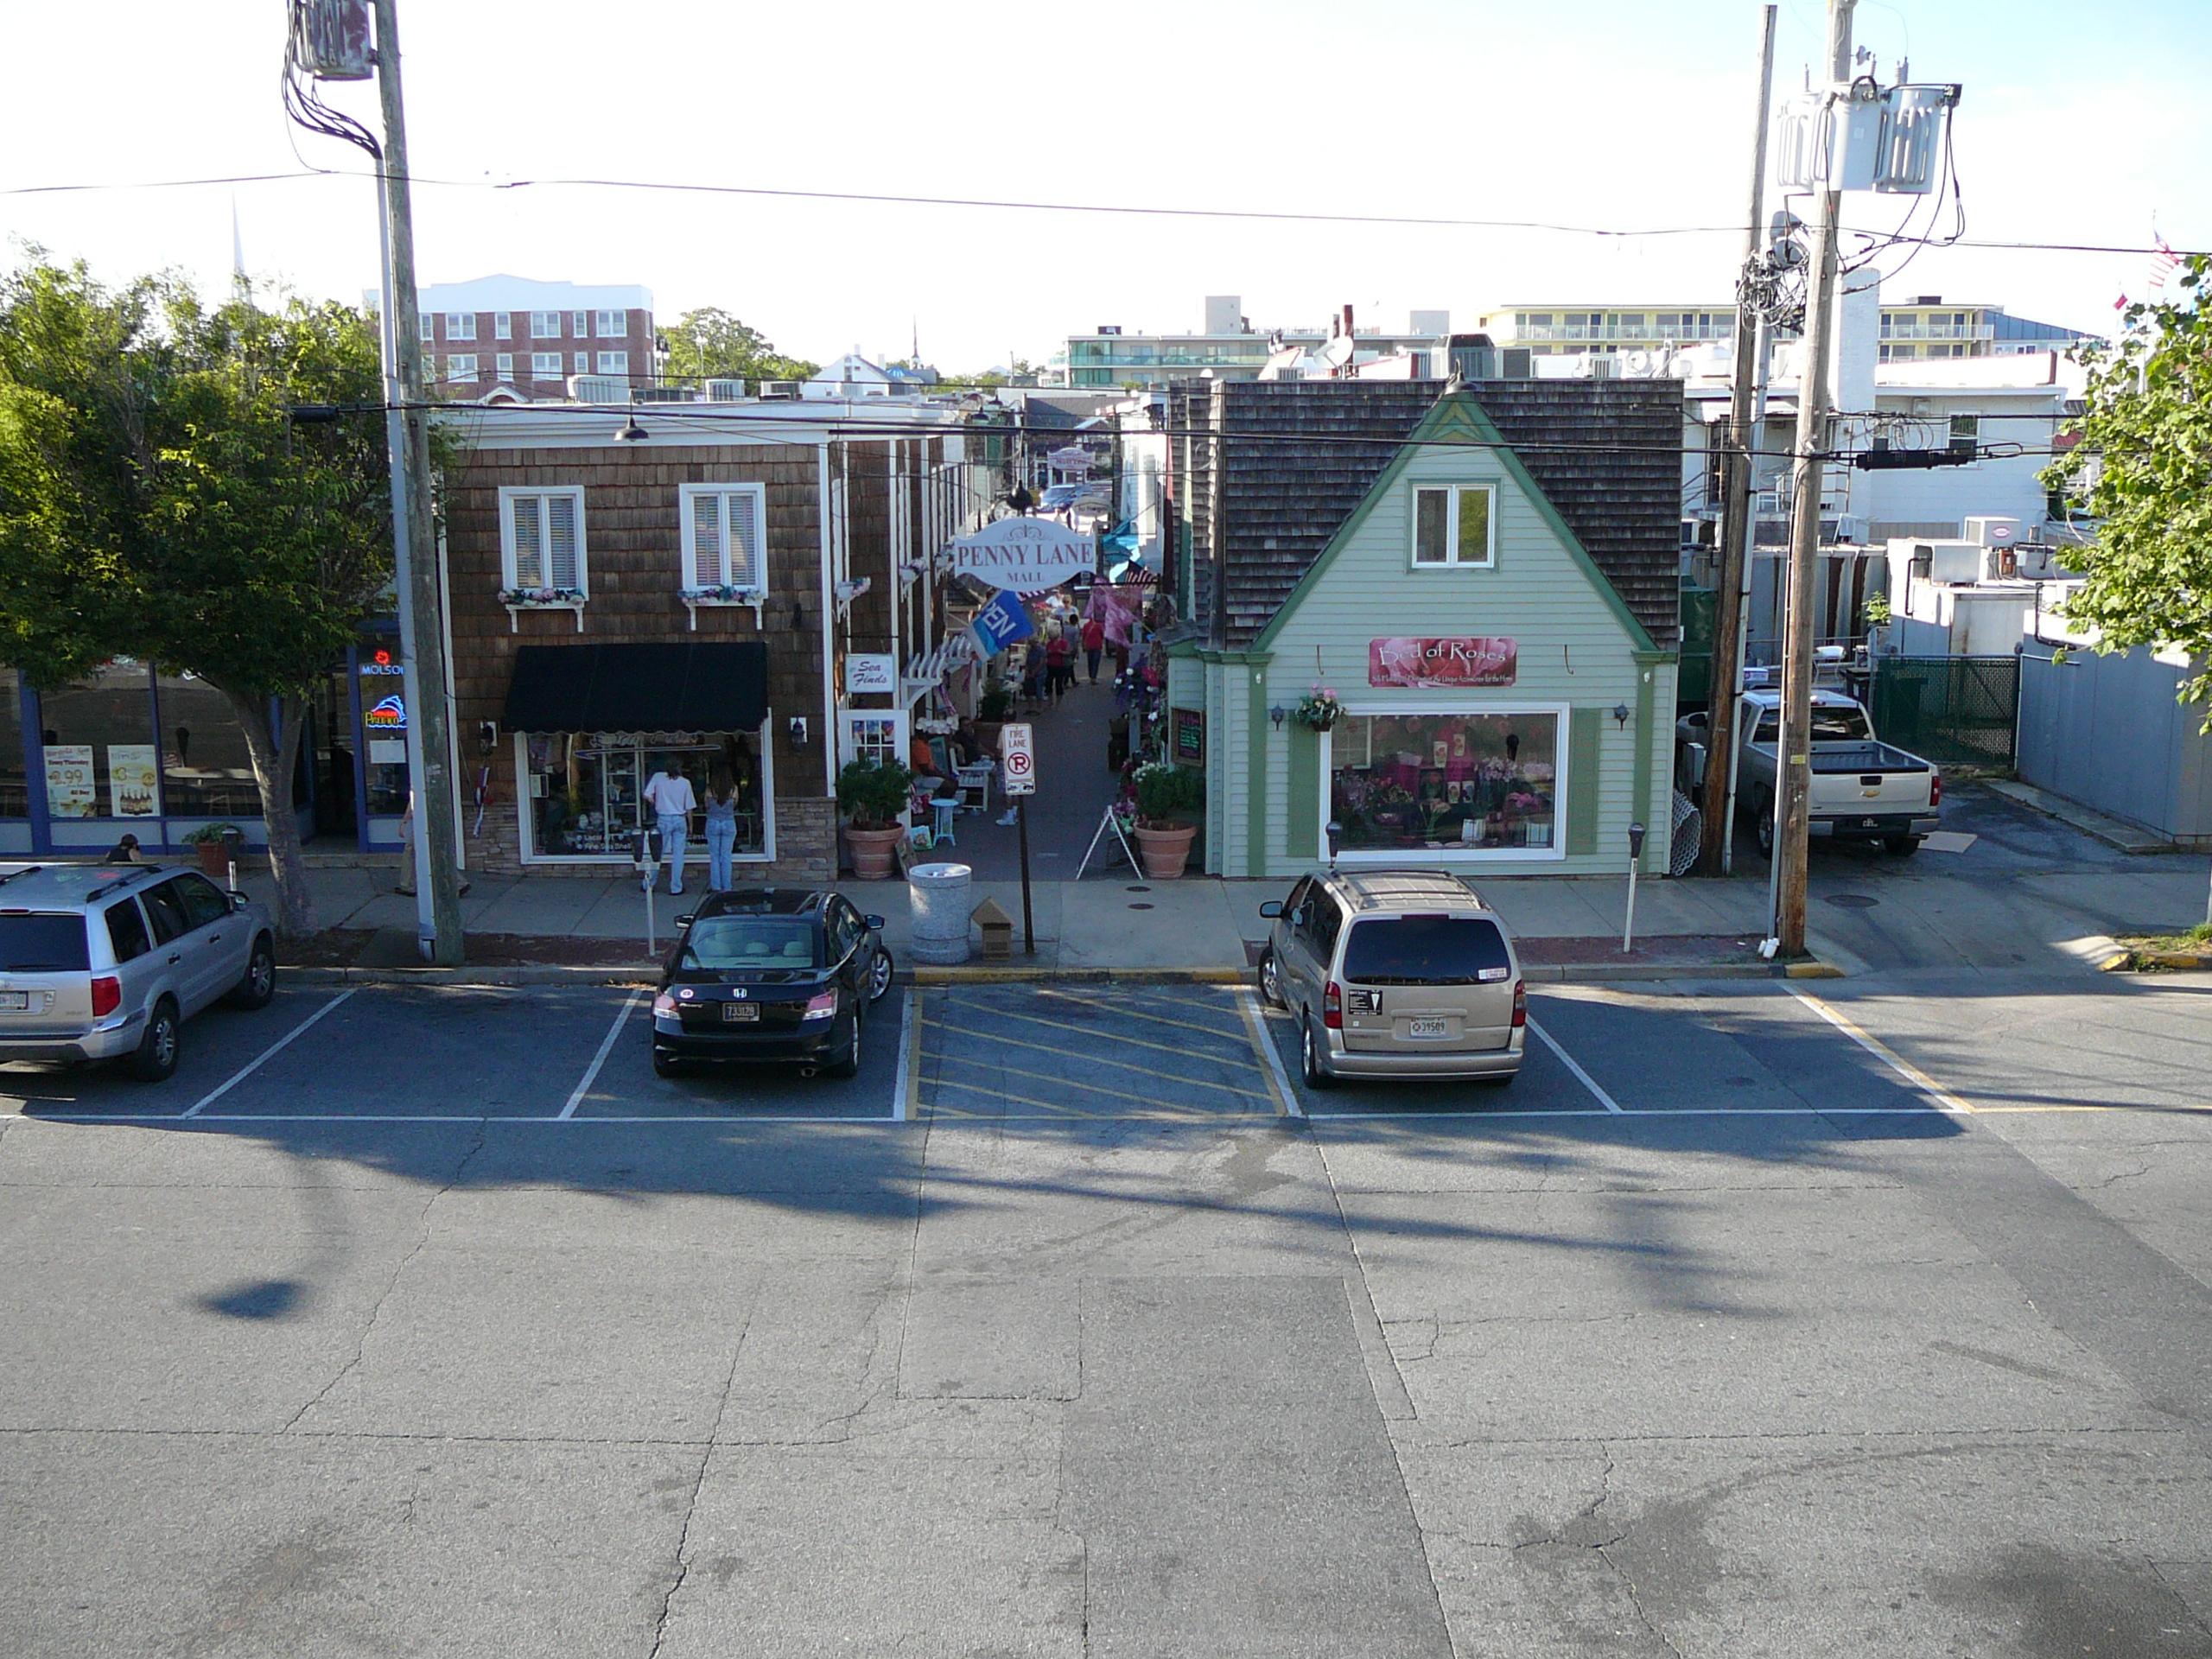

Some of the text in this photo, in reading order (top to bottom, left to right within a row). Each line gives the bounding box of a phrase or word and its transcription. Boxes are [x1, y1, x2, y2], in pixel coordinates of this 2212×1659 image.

[957, 543, 1094, 567] PENNY LANE
[1007, 572, 1046, 583] MALL
[982, 601, 1017, 639] PEN
[1378, 640, 1506, 665] Bed of Roses
[858, 661, 881, 672] Sea
[853, 673, 887, 687] Finds
[1009, 729, 1025, 738] FIRE
[1008, 739, 1027, 748] LANE
